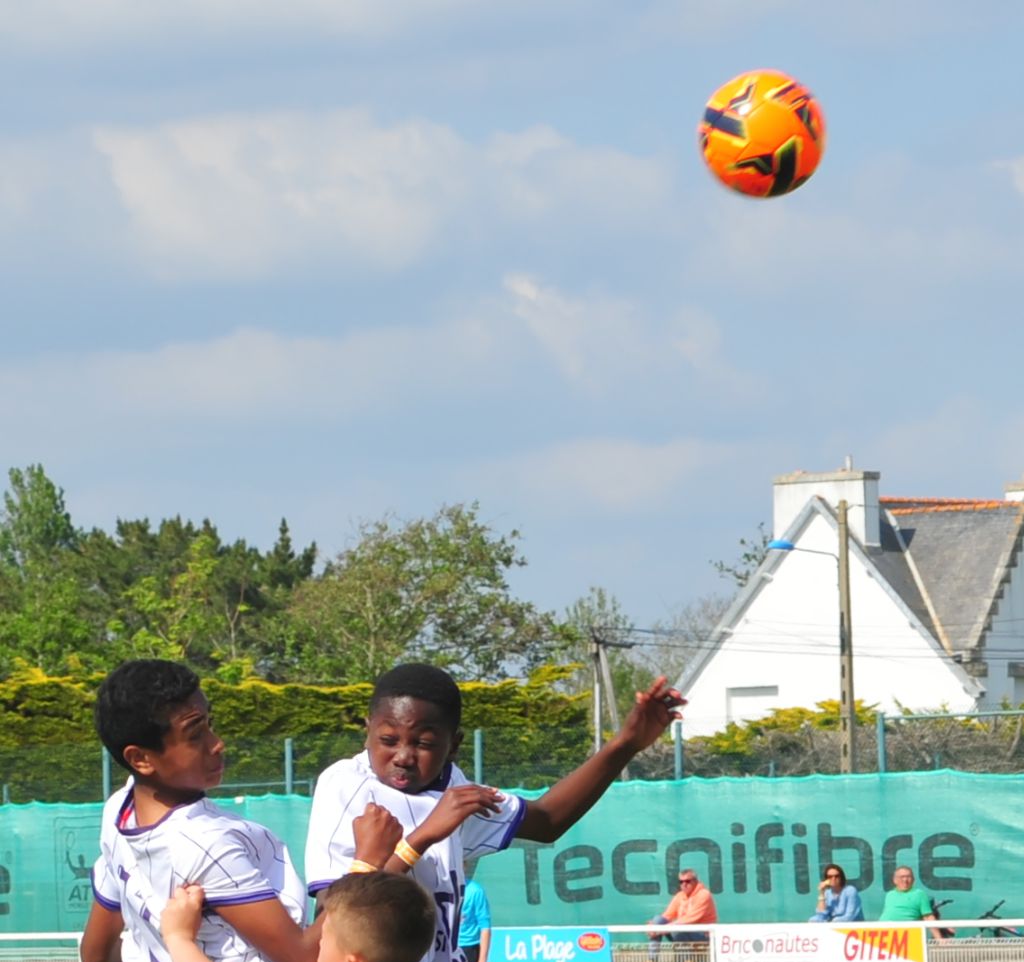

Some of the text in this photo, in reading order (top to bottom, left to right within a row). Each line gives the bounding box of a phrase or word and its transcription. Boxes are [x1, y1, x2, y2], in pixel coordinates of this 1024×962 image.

[513, 822, 976, 906] Tecnifibre
[69, 884, 91, 902] AT
[505, 934, 528, 961] La
[844, 929, 909, 962] GITEM
